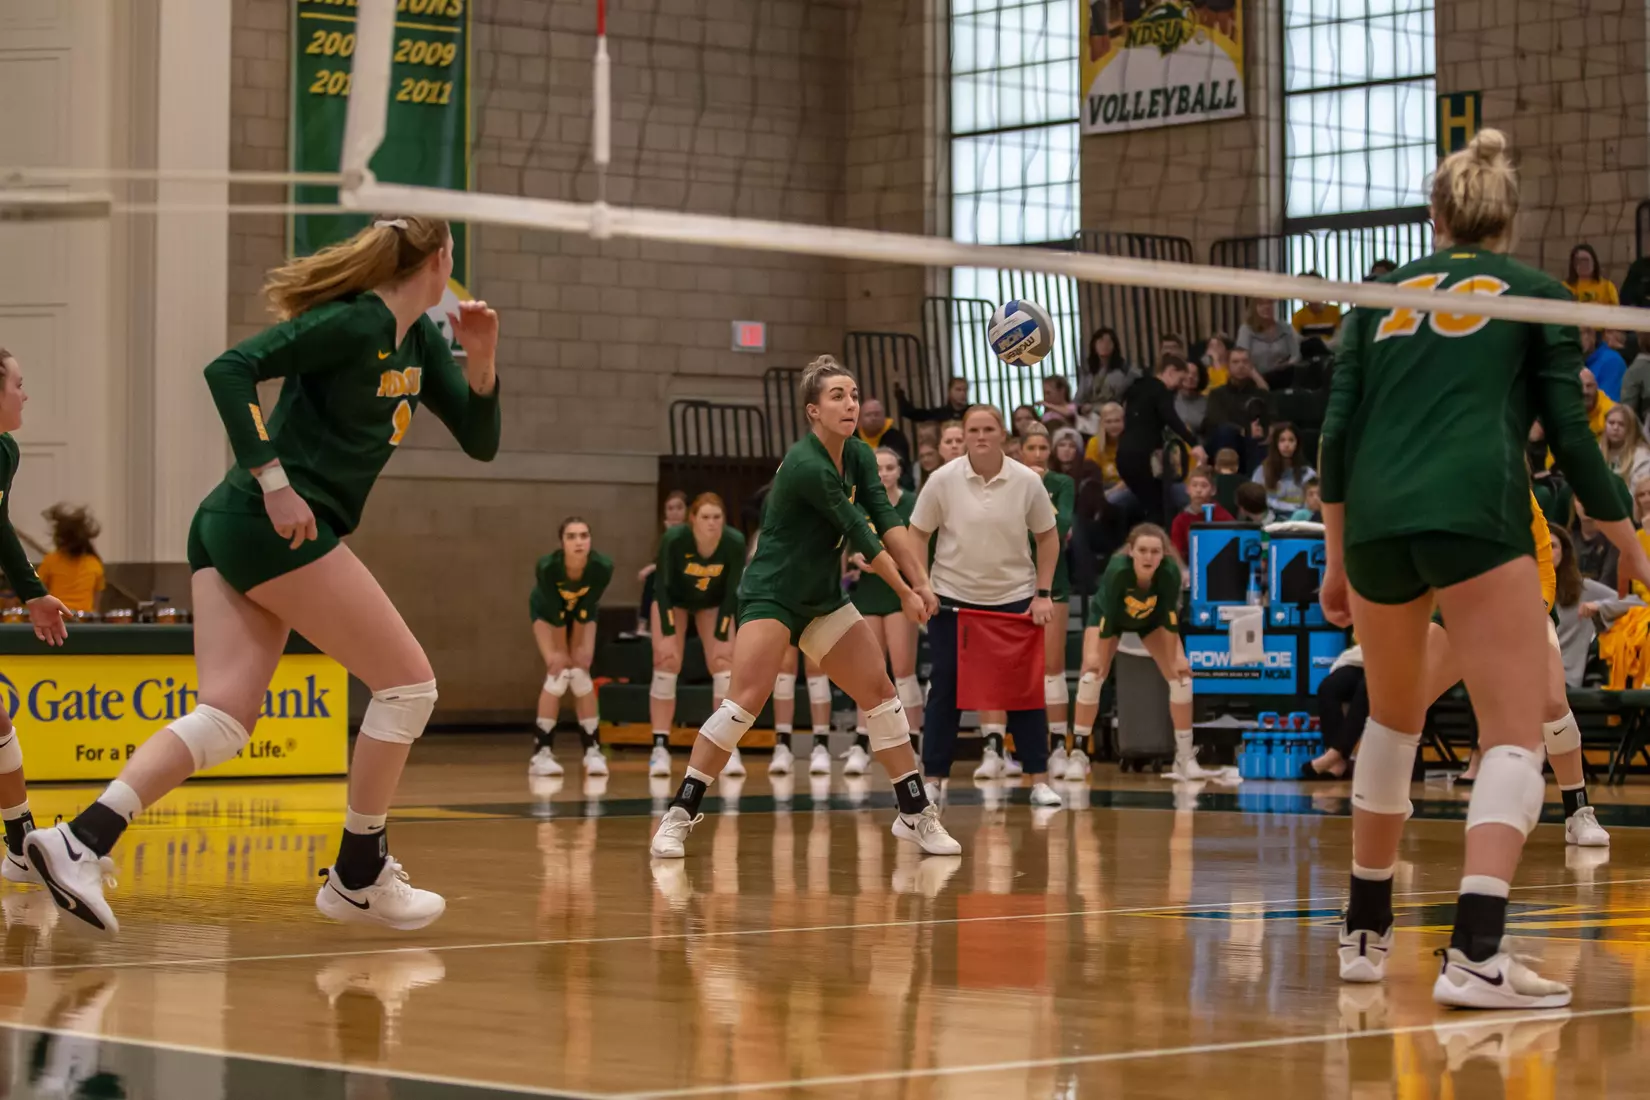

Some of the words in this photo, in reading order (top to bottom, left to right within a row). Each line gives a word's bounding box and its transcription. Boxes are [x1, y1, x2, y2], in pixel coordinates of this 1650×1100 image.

[305, 29, 355, 57] 200
[1125, 18, 1182, 49] NDSU
[394, 38, 456, 67] 2009
[308, 69, 352, 95] 201
[395, 77, 453, 104] 2011
[1089, 79, 1237, 125] VOLLEYBALL
[376, 366, 422, 397] NDSU
[1189, 651, 1292, 668] POWDE
[28, 679, 124, 722] Gate
[133, 676, 198, 721] Cit
[258, 674, 331, 718] ank
[75, 744, 105, 762] For
[110, 747, 120, 761] a
